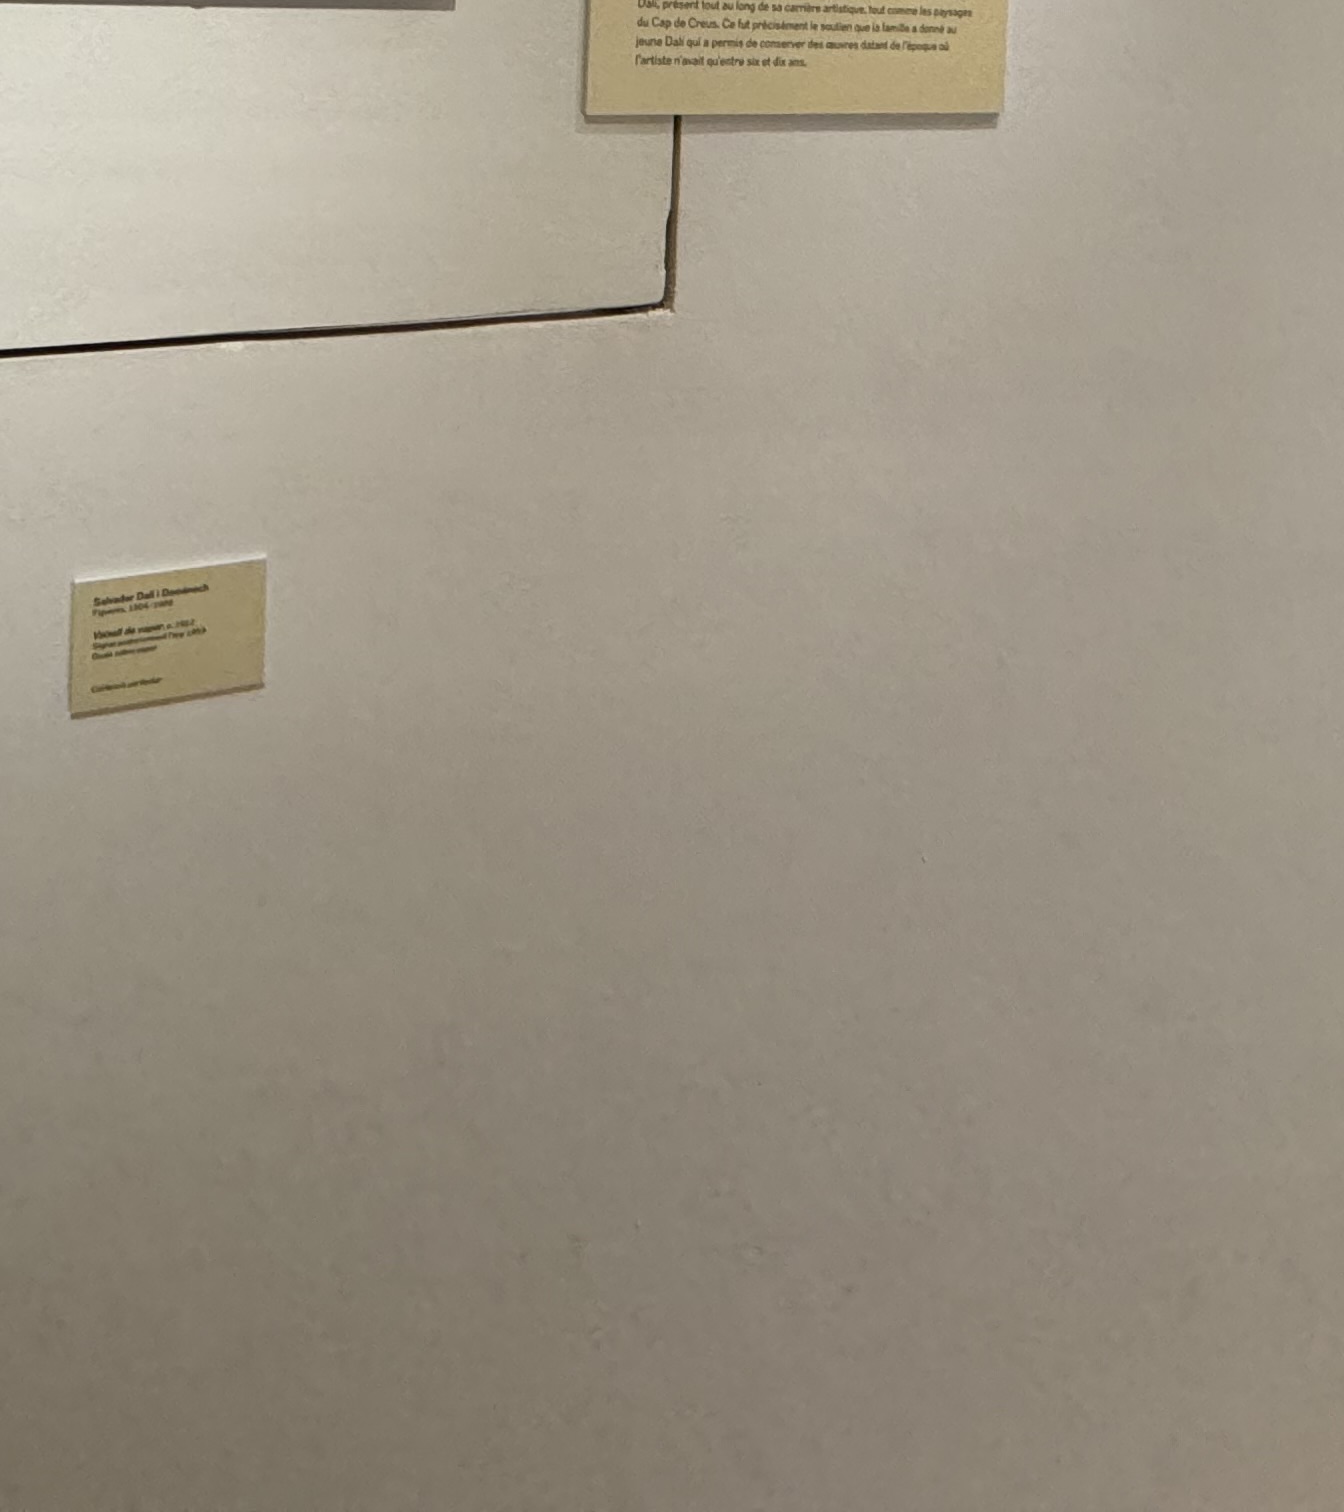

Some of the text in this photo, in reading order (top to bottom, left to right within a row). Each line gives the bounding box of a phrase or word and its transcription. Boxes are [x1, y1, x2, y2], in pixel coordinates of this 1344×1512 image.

[700, 0, 720, 11] tout
[721, 2, 734, 12] au
[735, 0, 756, 15] long
[636, 16, 649, 28] du
[650, 16, 672, 31] Cap
[673, 16, 686, 29] de
[721, 17, 735, 30] Ce
[737, 17, 750, 30] fut
[634, 35, 663, 51] jeune
[685, 36, 701, 51] qui
[710, 36, 744, 51] permis
[745, 36, 758, 49] de
[746, 54, 760, 66] six
[772, 54, 786, 67] dix
